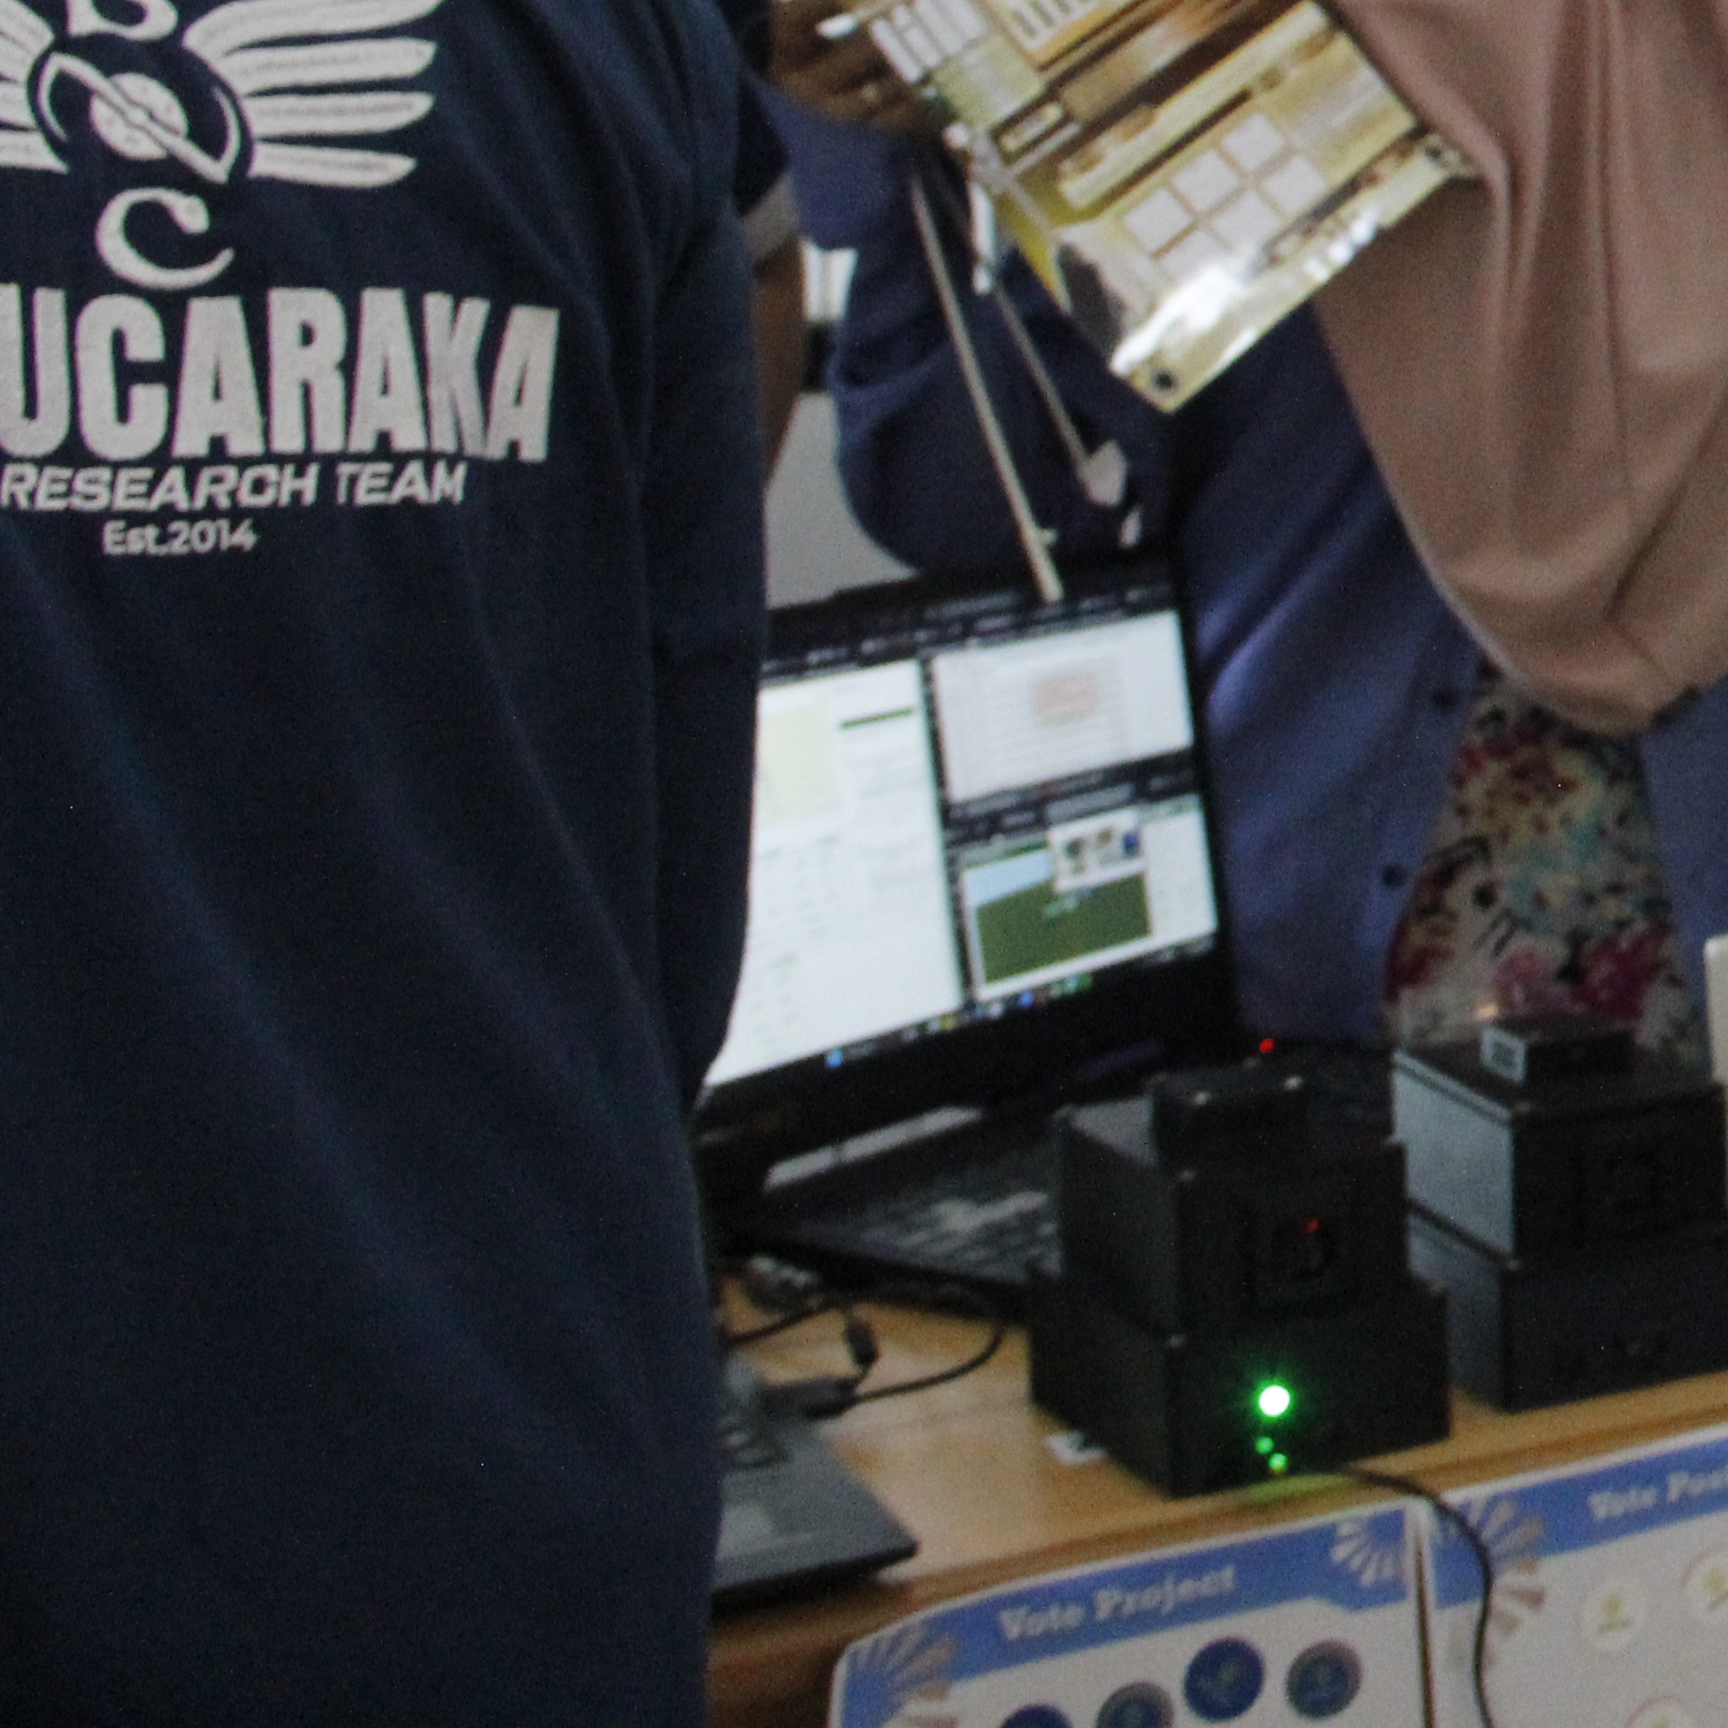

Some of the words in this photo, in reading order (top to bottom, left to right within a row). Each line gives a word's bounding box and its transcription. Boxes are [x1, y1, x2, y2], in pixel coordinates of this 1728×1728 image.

[0, 460, 322, 512] RESEARCH
[335, 458, 469, 506] TEAM
[102, 518, 260, 557] Est.2014
[1094, 1564, 1236, 1621] Project
